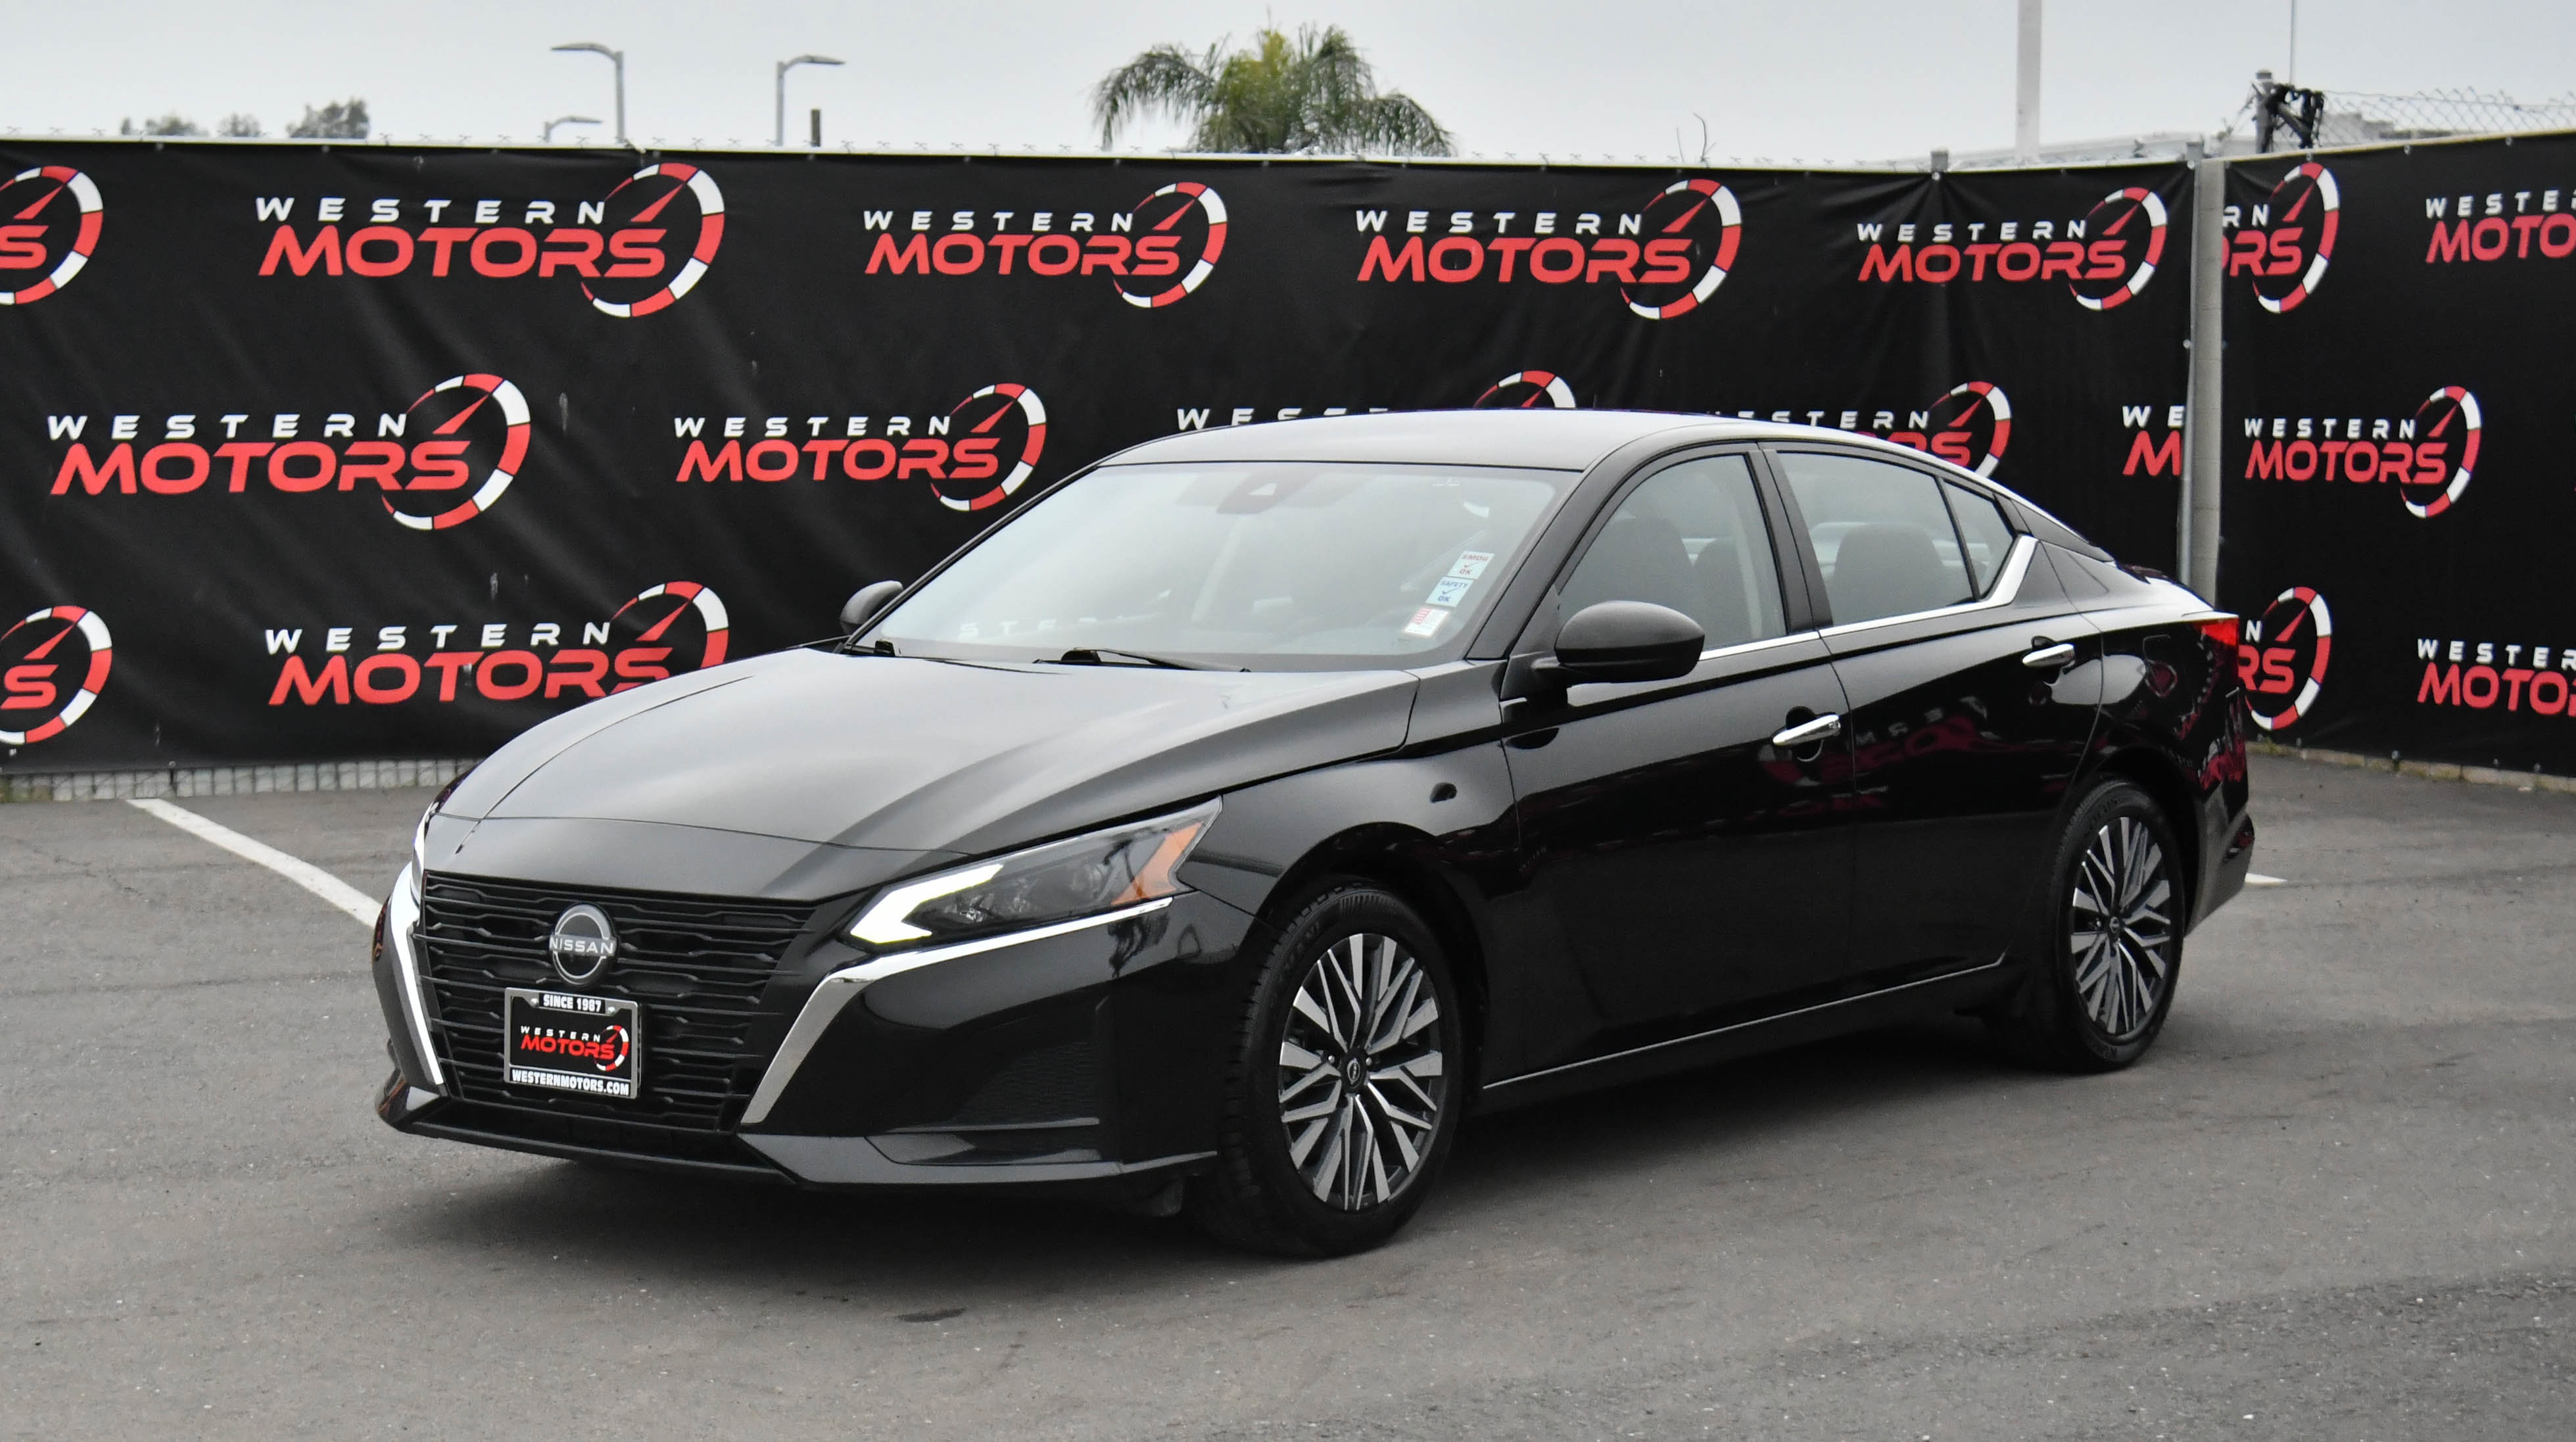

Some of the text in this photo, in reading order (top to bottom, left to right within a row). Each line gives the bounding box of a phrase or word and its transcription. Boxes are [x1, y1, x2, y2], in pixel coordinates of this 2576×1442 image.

[256, 198, 604, 224] WESTERN
[864, 211, 1132, 231] WESTERN
[1356, 210, 1641, 234] WESTERN
[1857, 220, 2086, 242] WESTERN
[2427, 214, 2576, 263] MOTO
[260, 225, 666, 277] MOTORS
[866, 233, 1181, 276] MOTORS
[1358, 235, 1692, 283] MOTORS
[1859, 241, 2126, 283] MOTORS
[2222, 228, 2303, 277] RS
[48, 414, 406, 440] WESTERN
[675, 416, 950, 437] WESTERN
[1177, 408, 1388, 430] WES
[1714, 410, 1928, 429] STERN
[2245, 419, 2414, 439] WESTERN
[51, 441, 470, 495] MOTORS
[677, 438, 999, 482] MOTORS
[2246, 441, 2447, 484] MOTORS
[1441, 580, 1469, 589] SAFETY
[266, 623, 609, 654] WESTERN
[2418, 639, 2576, 670] WESTER
[269, 648, 672, 705] MOTORS
[549, 936, 615, 954] NISSAN
[543, 994, 602, 1013] SINCE 1987
[521, 1026, 600, 1042] WESTERN
[521, 1034, 615, 1059] MOTORS
[512, 1069, 629, 1095] WESTERNMOTORS.COM
